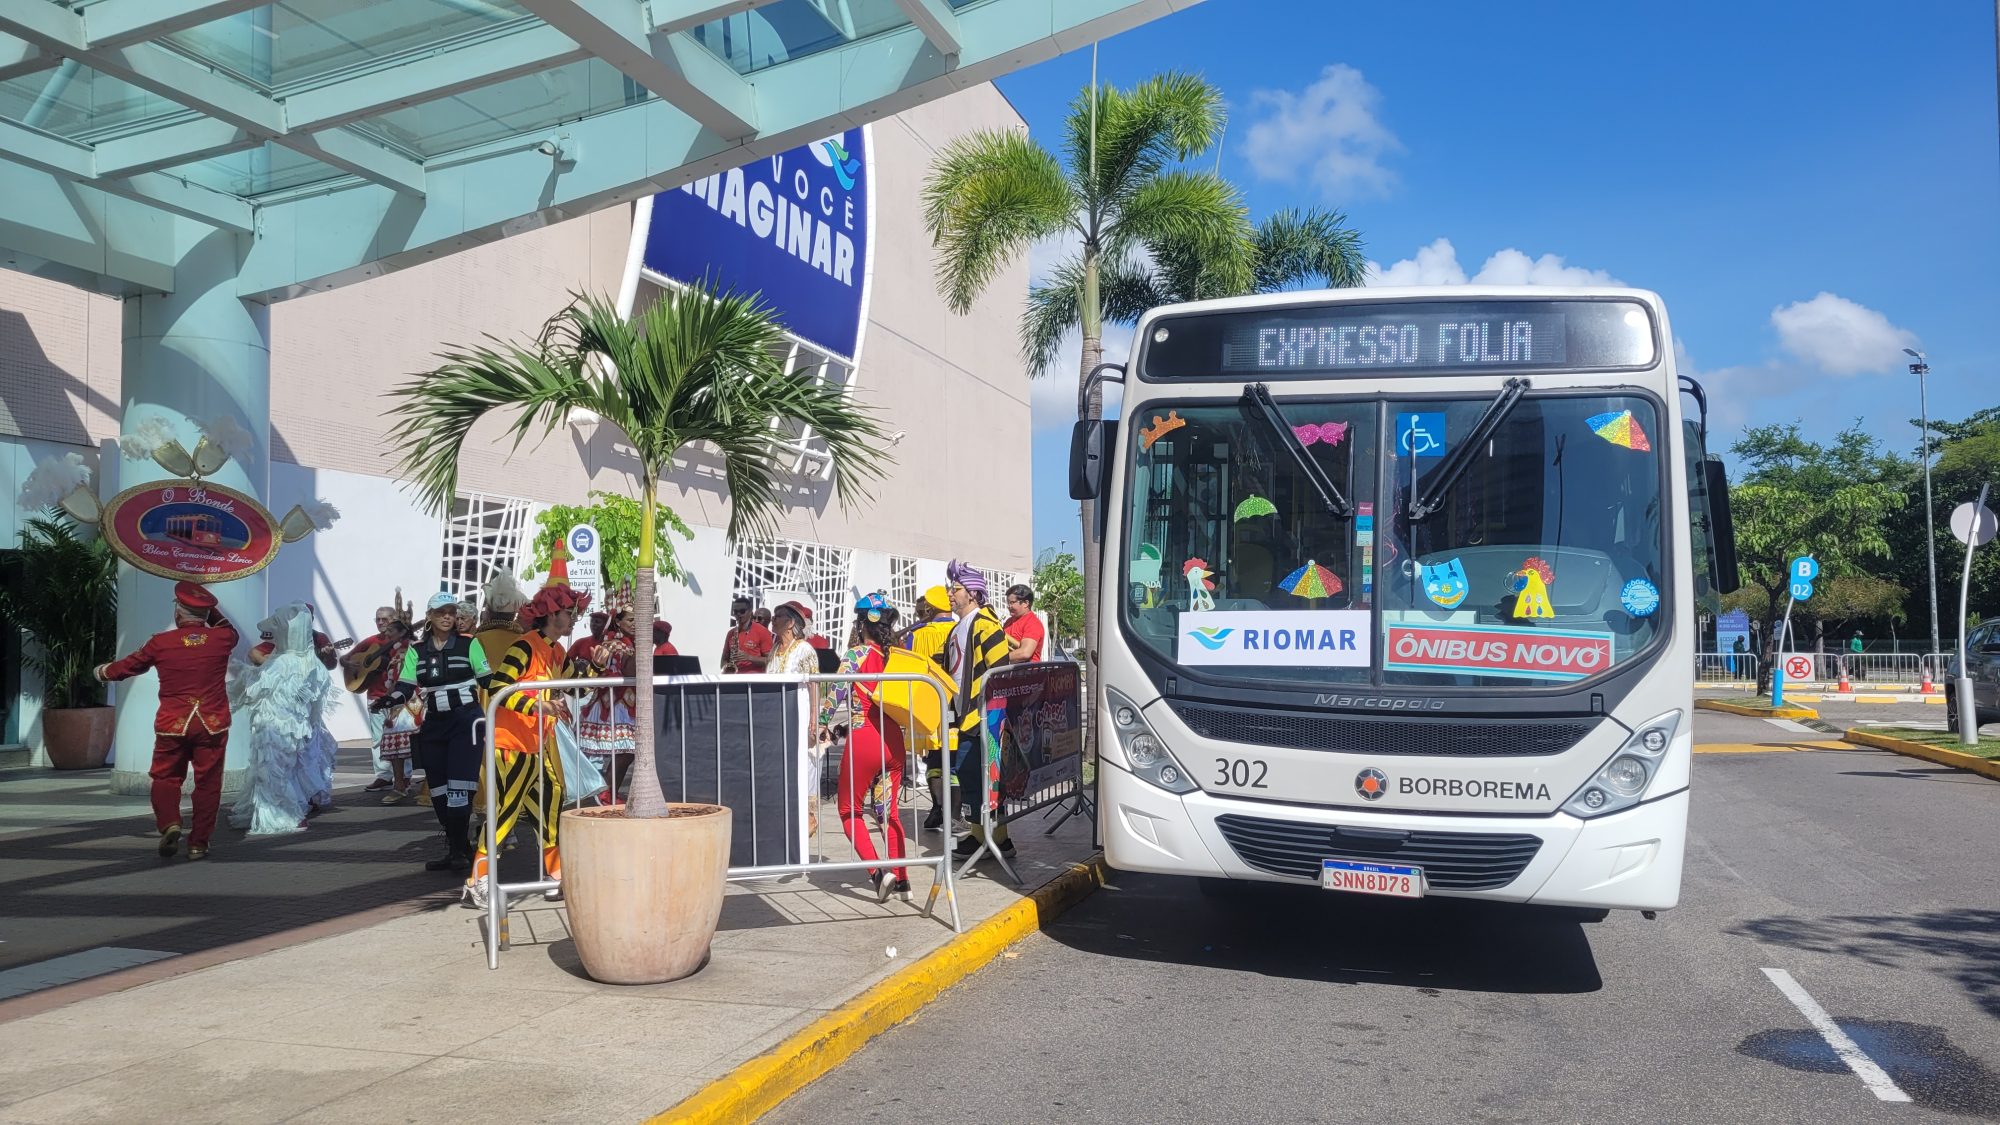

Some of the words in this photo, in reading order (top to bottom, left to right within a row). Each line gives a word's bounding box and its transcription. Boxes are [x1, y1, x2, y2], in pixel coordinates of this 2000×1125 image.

[772, 154, 854, 230] VOCÊ
[681, 166, 855, 287] MAGINAR
[1258, 324, 1419, 366] EXPRESSO
[1438, 321, 1533, 362] FOLIA
[162, 487, 175, 503] O
[187, 486, 235, 513] Bonde
[142, 544, 170, 556] Bloco
[171, 546, 225, 562] Carnavalesco
[579, 567, 596, 576] TÁXI
[1798, 562, 1811, 577] B
[570, 580, 596, 588] mbarque
[1792, 584, 1809, 596] 02
[1243, 629, 1357, 651] RIOMAR
[1395, 633, 1508, 662] ÔNIBUS
[1512, 643, 1601, 668] NOVO
[1313, 693, 1446, 711] Marcopolo
[1214, 758, 1269, 789] 302
[1399, 777, 1552, 800] BORBOREMA
[1332, 871, 1410, 893] SNN8D78
